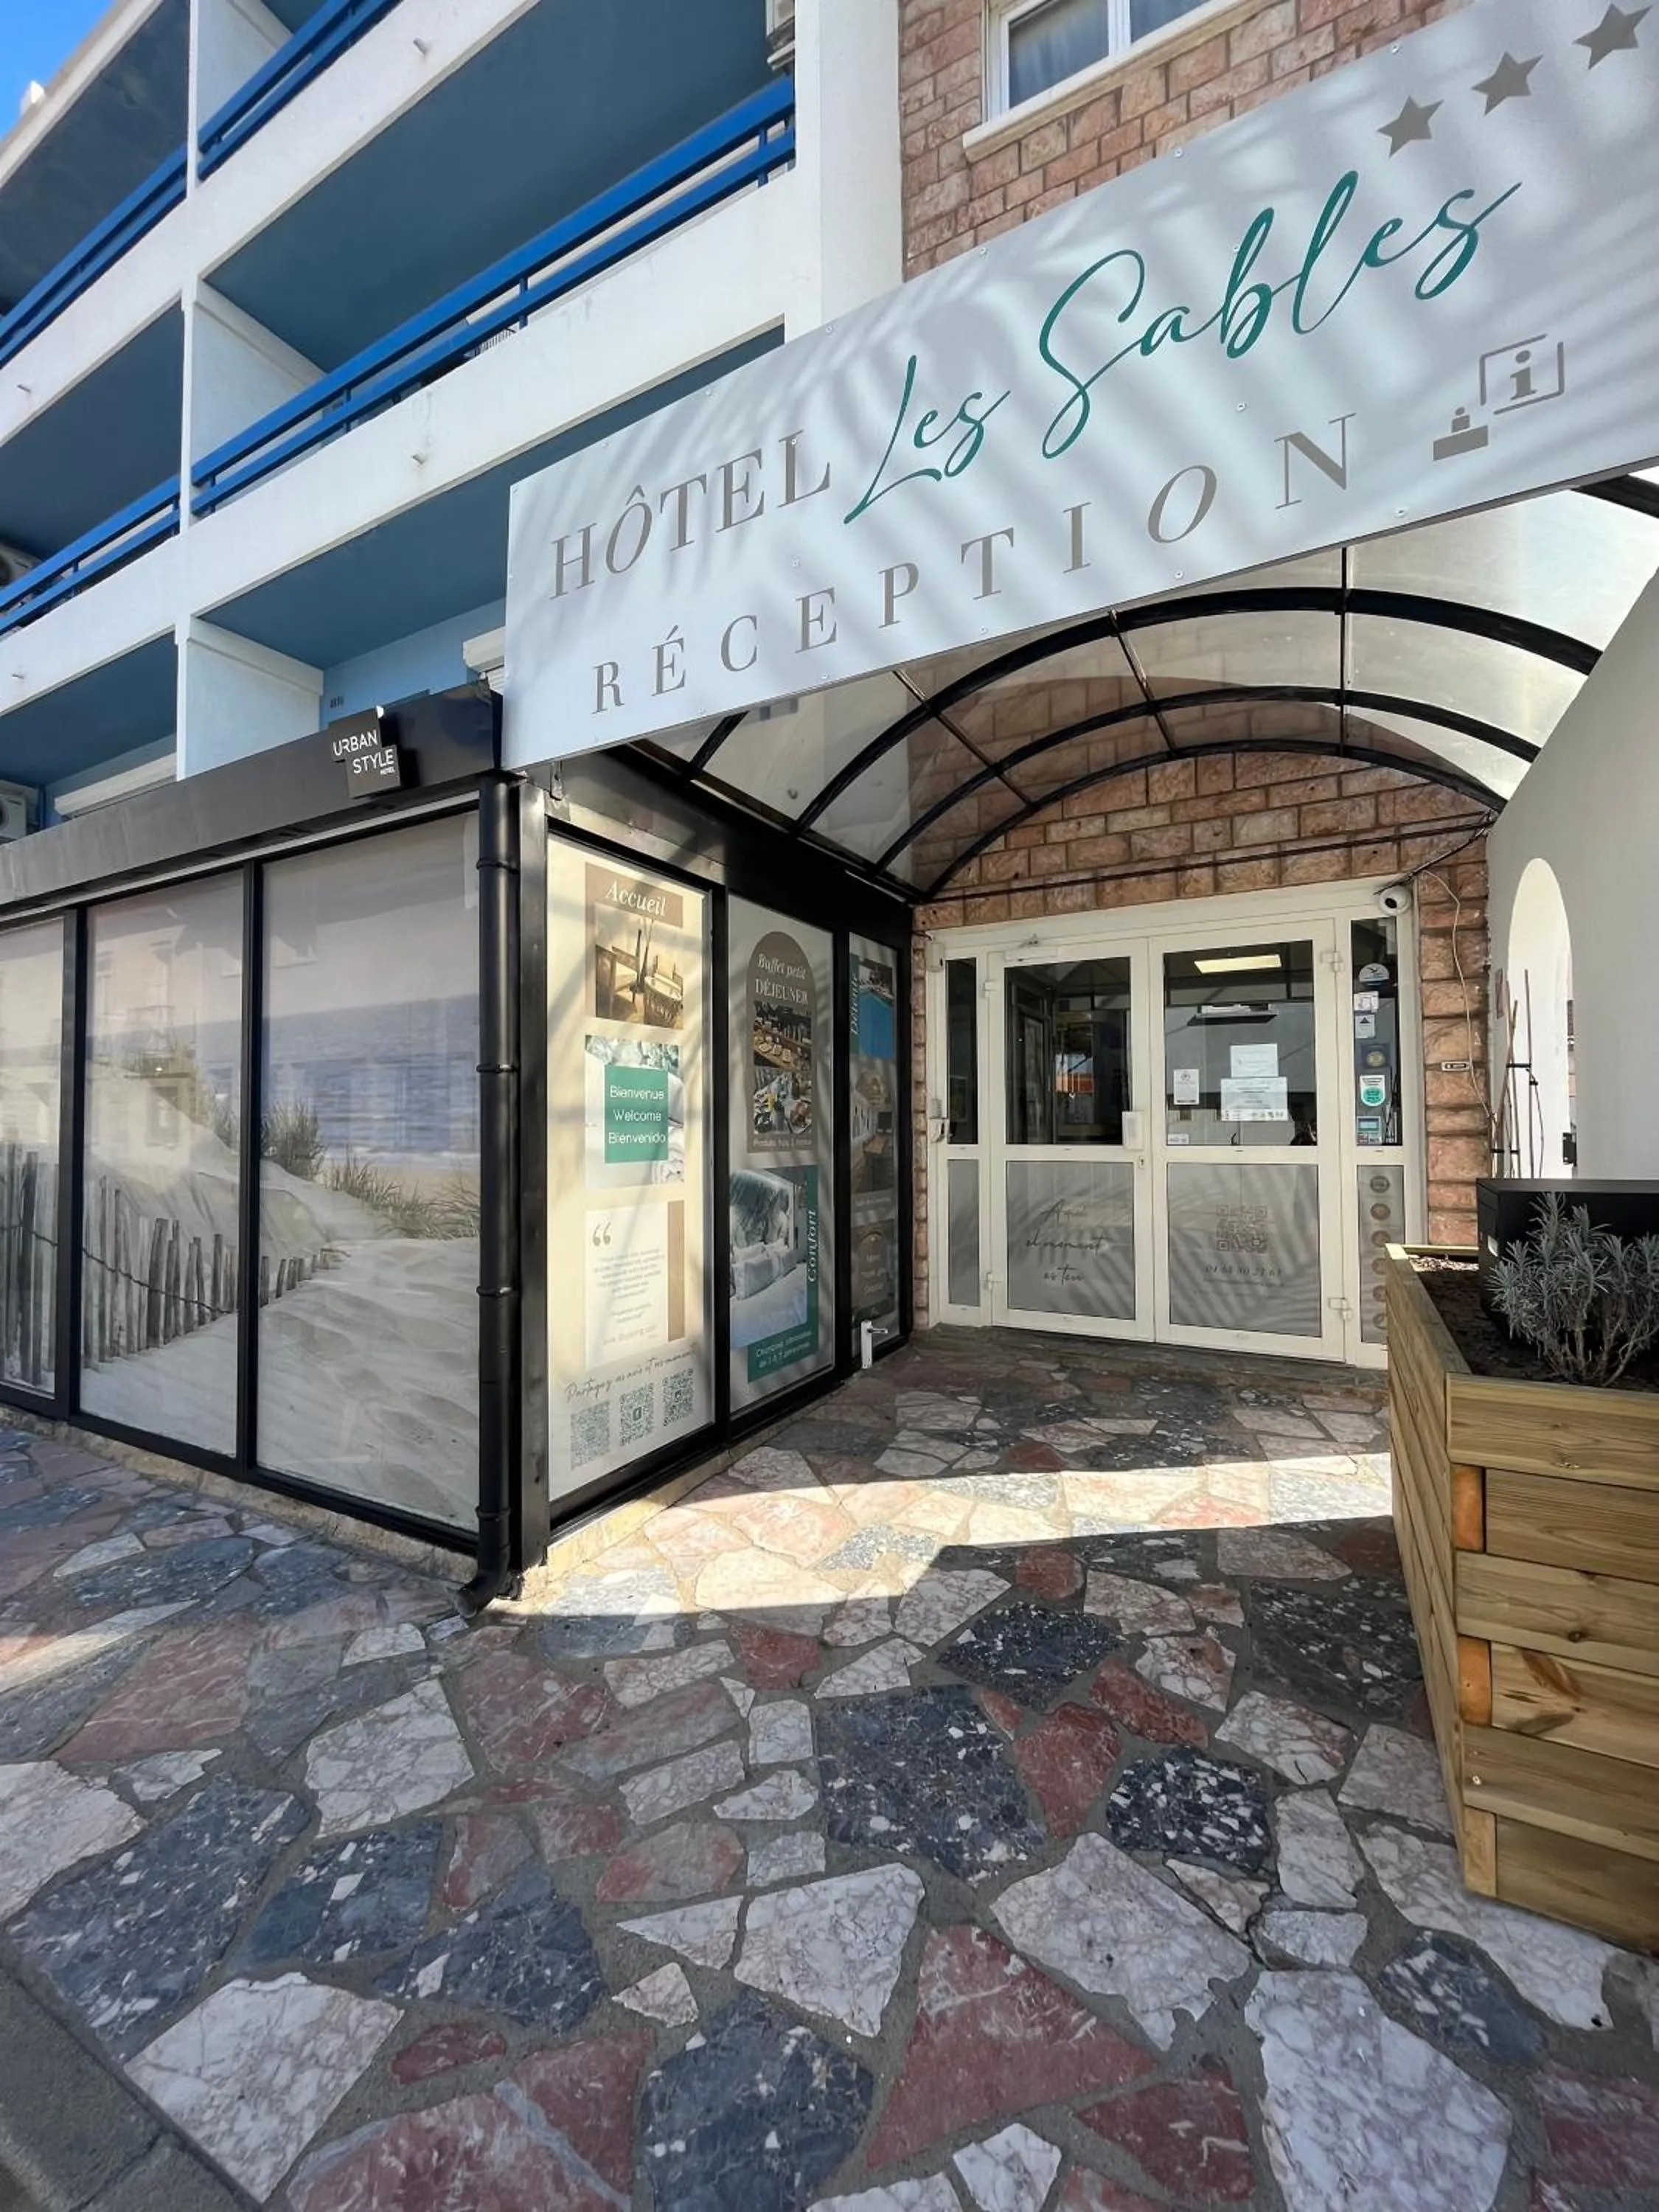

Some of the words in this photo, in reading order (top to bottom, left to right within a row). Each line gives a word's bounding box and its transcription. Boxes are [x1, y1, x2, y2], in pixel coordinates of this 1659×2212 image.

[549, 428, 832, 601] HÔTEL
[843, 355, 1012, 526] Les
[1038, 170, 1523, 462] Sables
[592, 412, 1357, 714] RÉCEPTION
[333, 729, 378, 756] URBAN
[352, 748, 394, 773] STYLE
[605, 880, 667, 917] Accueil
[755, 977, 809, 1005] DÉJEUNER
[609, 1084, 664, 1102] Bienvenue
[613, 1108, 662, 1121] Welcome
[608, 1131, 667, 1144] Bienvenido
[807, 1210, 817, 1281] Confort
